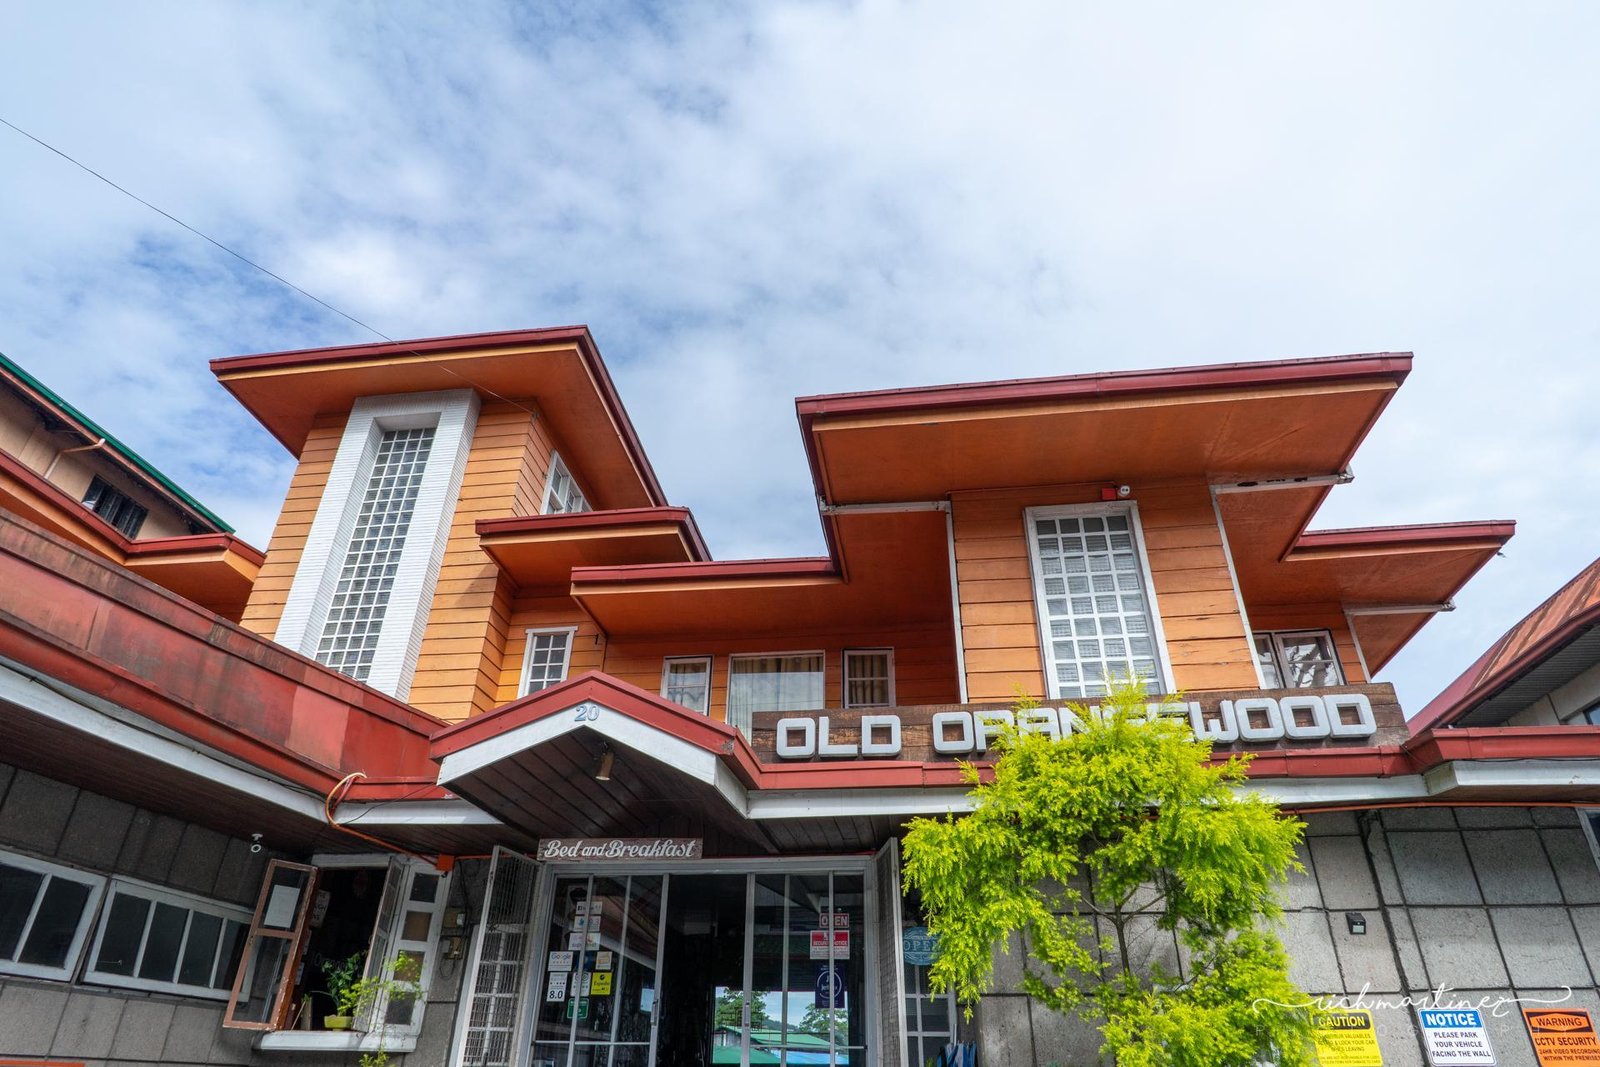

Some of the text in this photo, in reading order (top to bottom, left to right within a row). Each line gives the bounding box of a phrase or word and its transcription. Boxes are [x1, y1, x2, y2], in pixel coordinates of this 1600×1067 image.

[574, 704, 600, 722] 20
[776, 714, 901, 758] OLD
[544, 839, 697, 858] Bed and Breakfast
[821, 916, 848, 926] OEN
[549, 990, 564, 999] 8.0
[1318, 1015, 1366, 1027] CAUTION
[1425, 1012, 1477, 1026] NOTICE
[1536, 1017, 1583, 1027] WARNING
[1534, 1036, 1597, 1046] CCTV SECURITY
[1432, 1050, 1457, 1058] FACING
